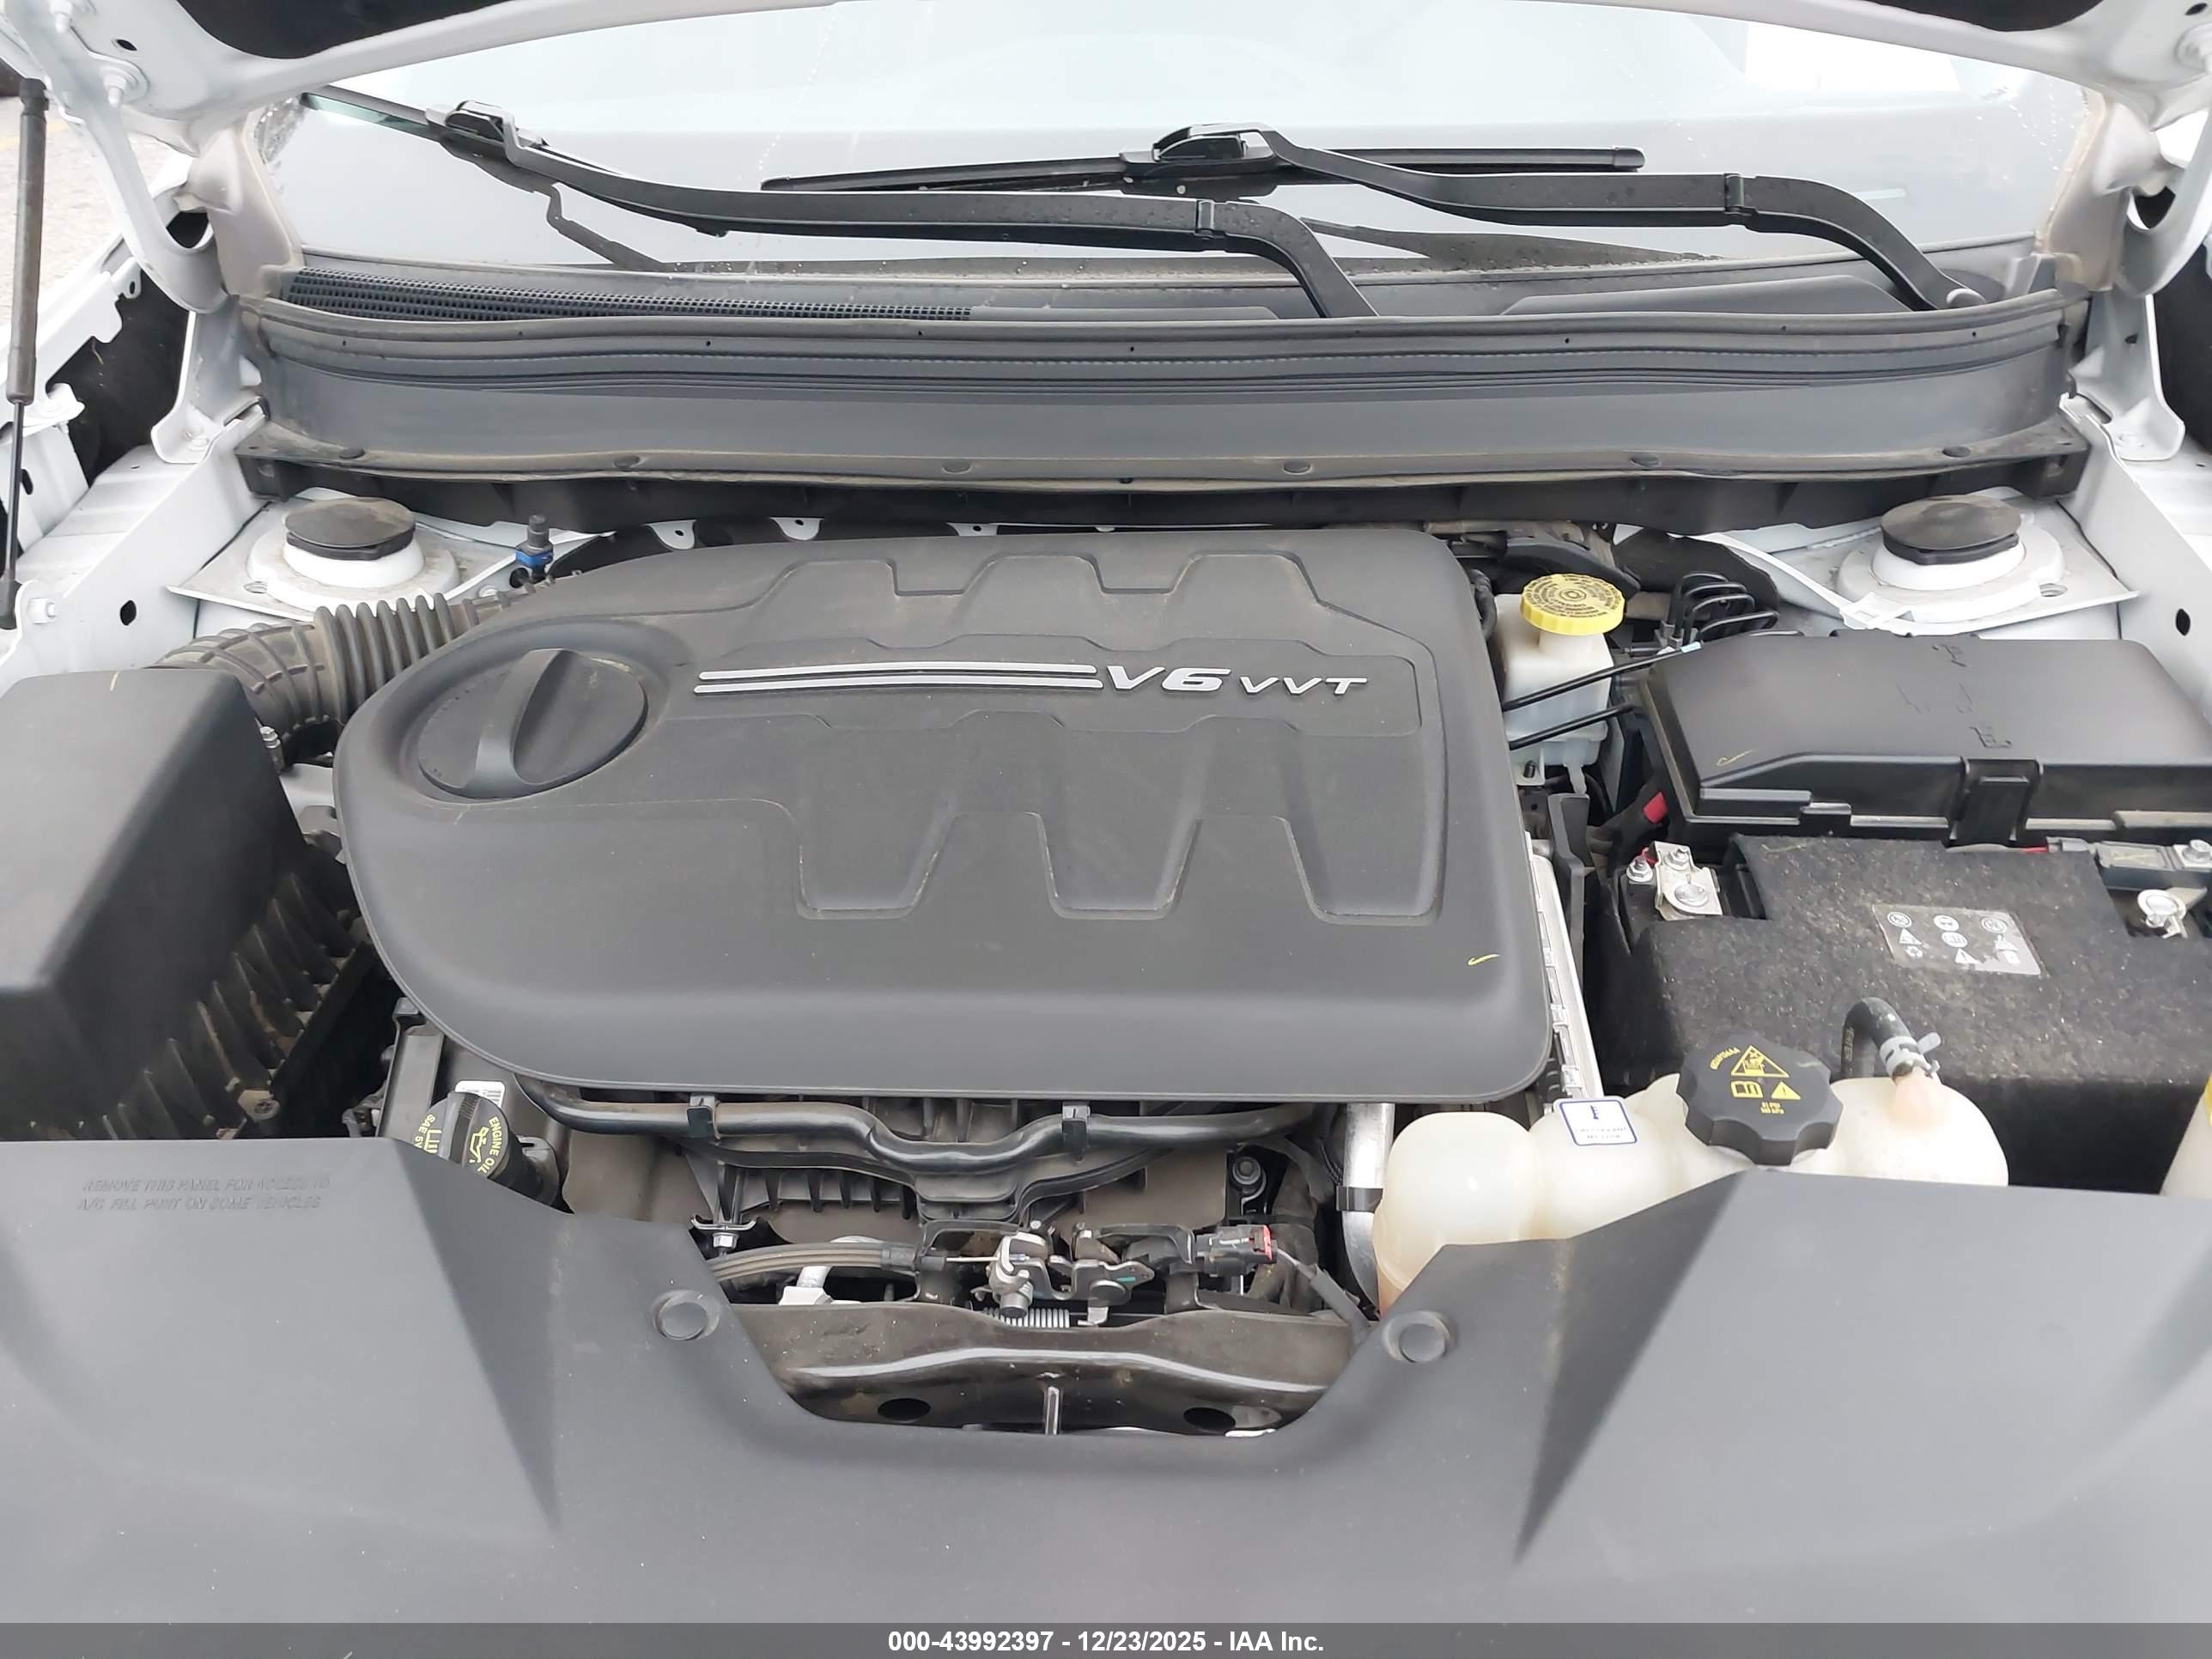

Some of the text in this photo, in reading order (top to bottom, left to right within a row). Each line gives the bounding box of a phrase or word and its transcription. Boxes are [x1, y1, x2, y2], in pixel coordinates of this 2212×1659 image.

[1107, 665, 1368, 695] V6 VVT
[418, 1114, 436, 1134] SAE
[477, 1116, 502, 1174] ENGINE OIL
